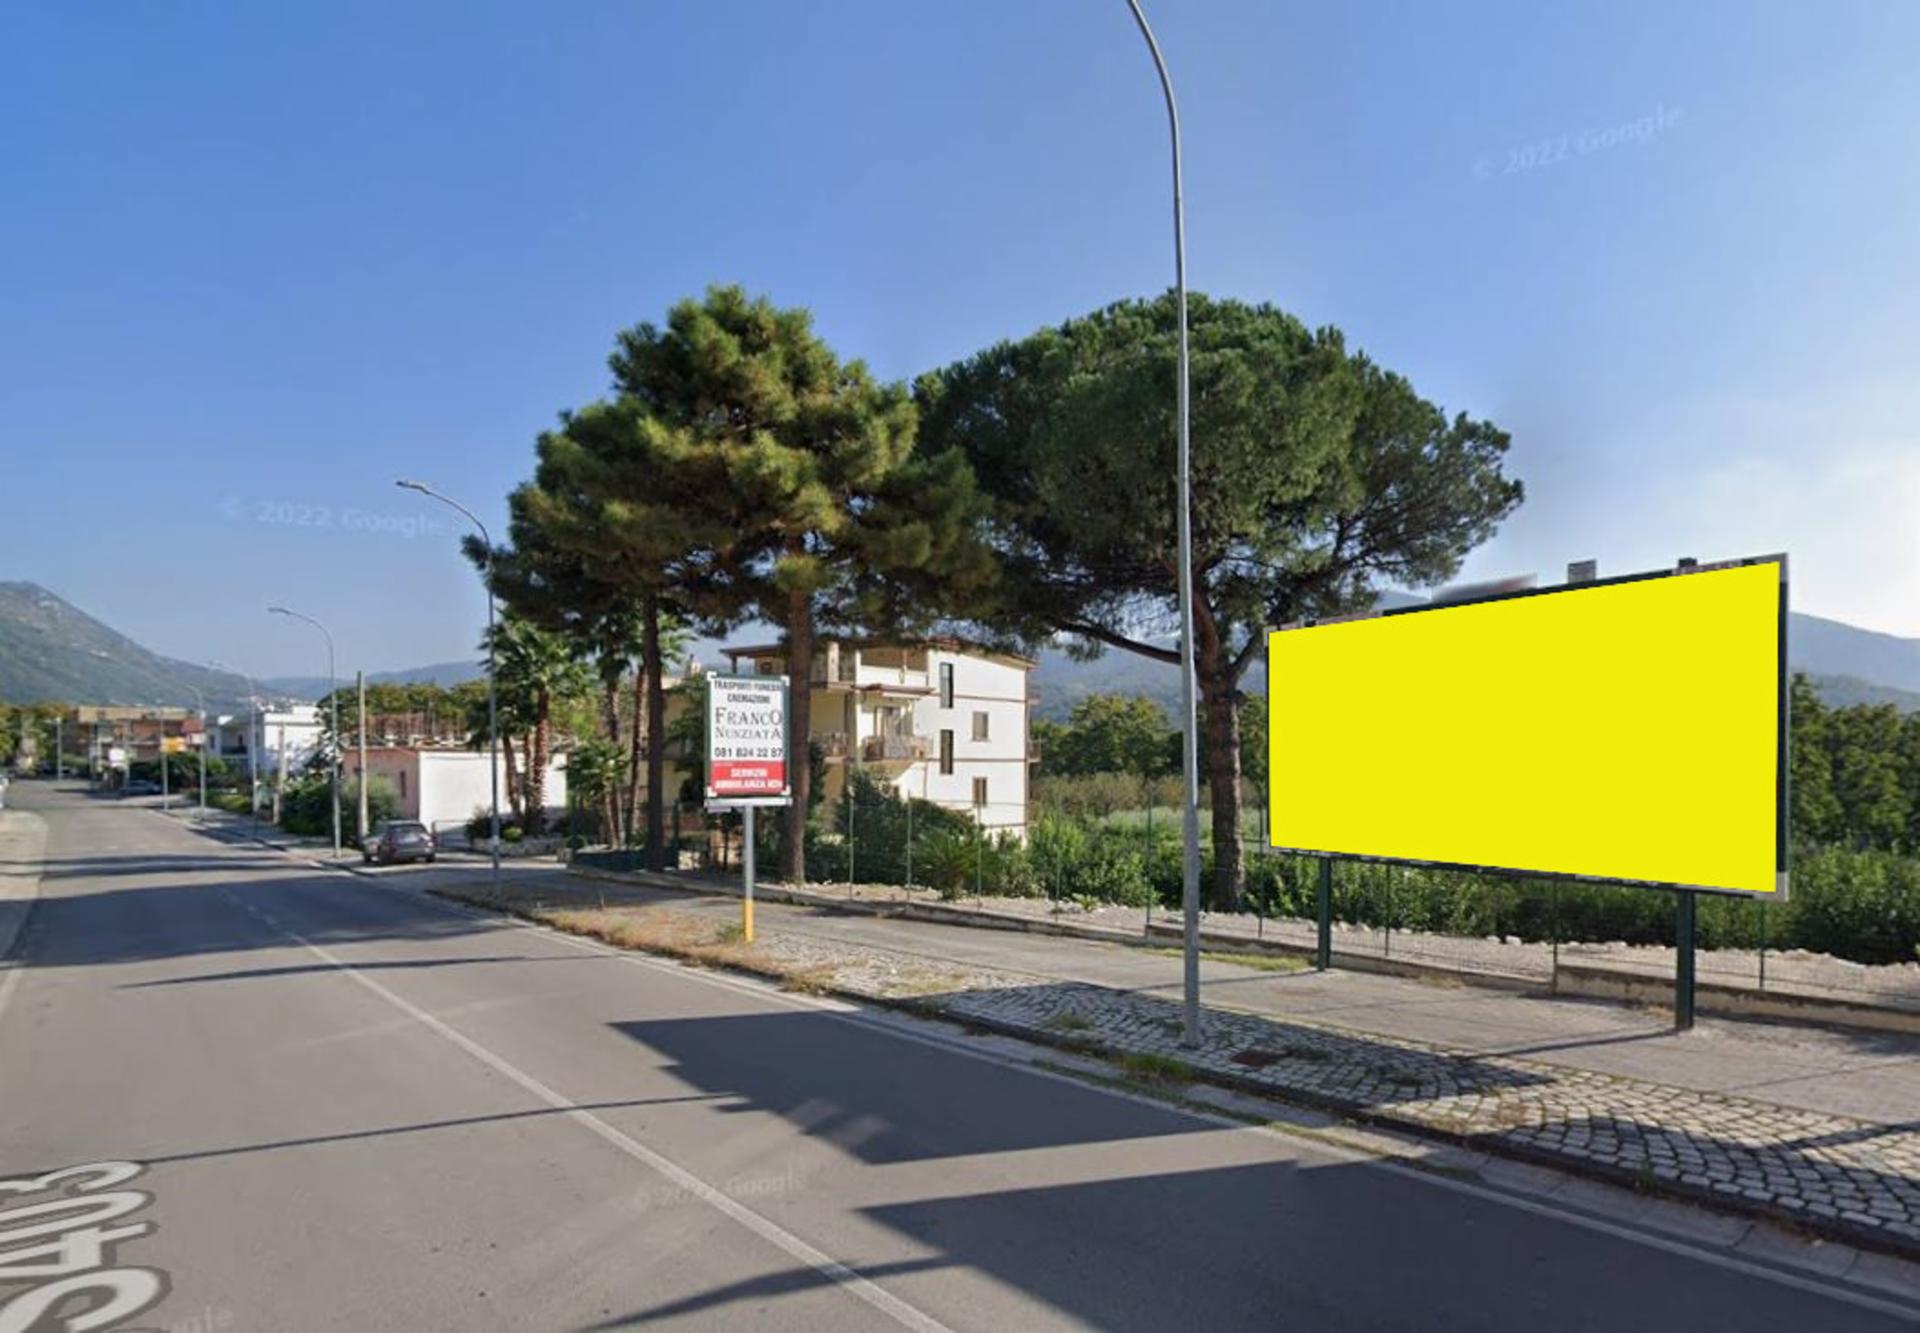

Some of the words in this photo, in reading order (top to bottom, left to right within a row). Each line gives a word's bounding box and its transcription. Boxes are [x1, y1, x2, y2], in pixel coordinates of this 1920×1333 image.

[715, 706, 783, 726] FRANCO
[715, 726, 783, 740] NUNZIATA
[715, 746, 732, 758] 081
[757, 746, 768, 758] 22
